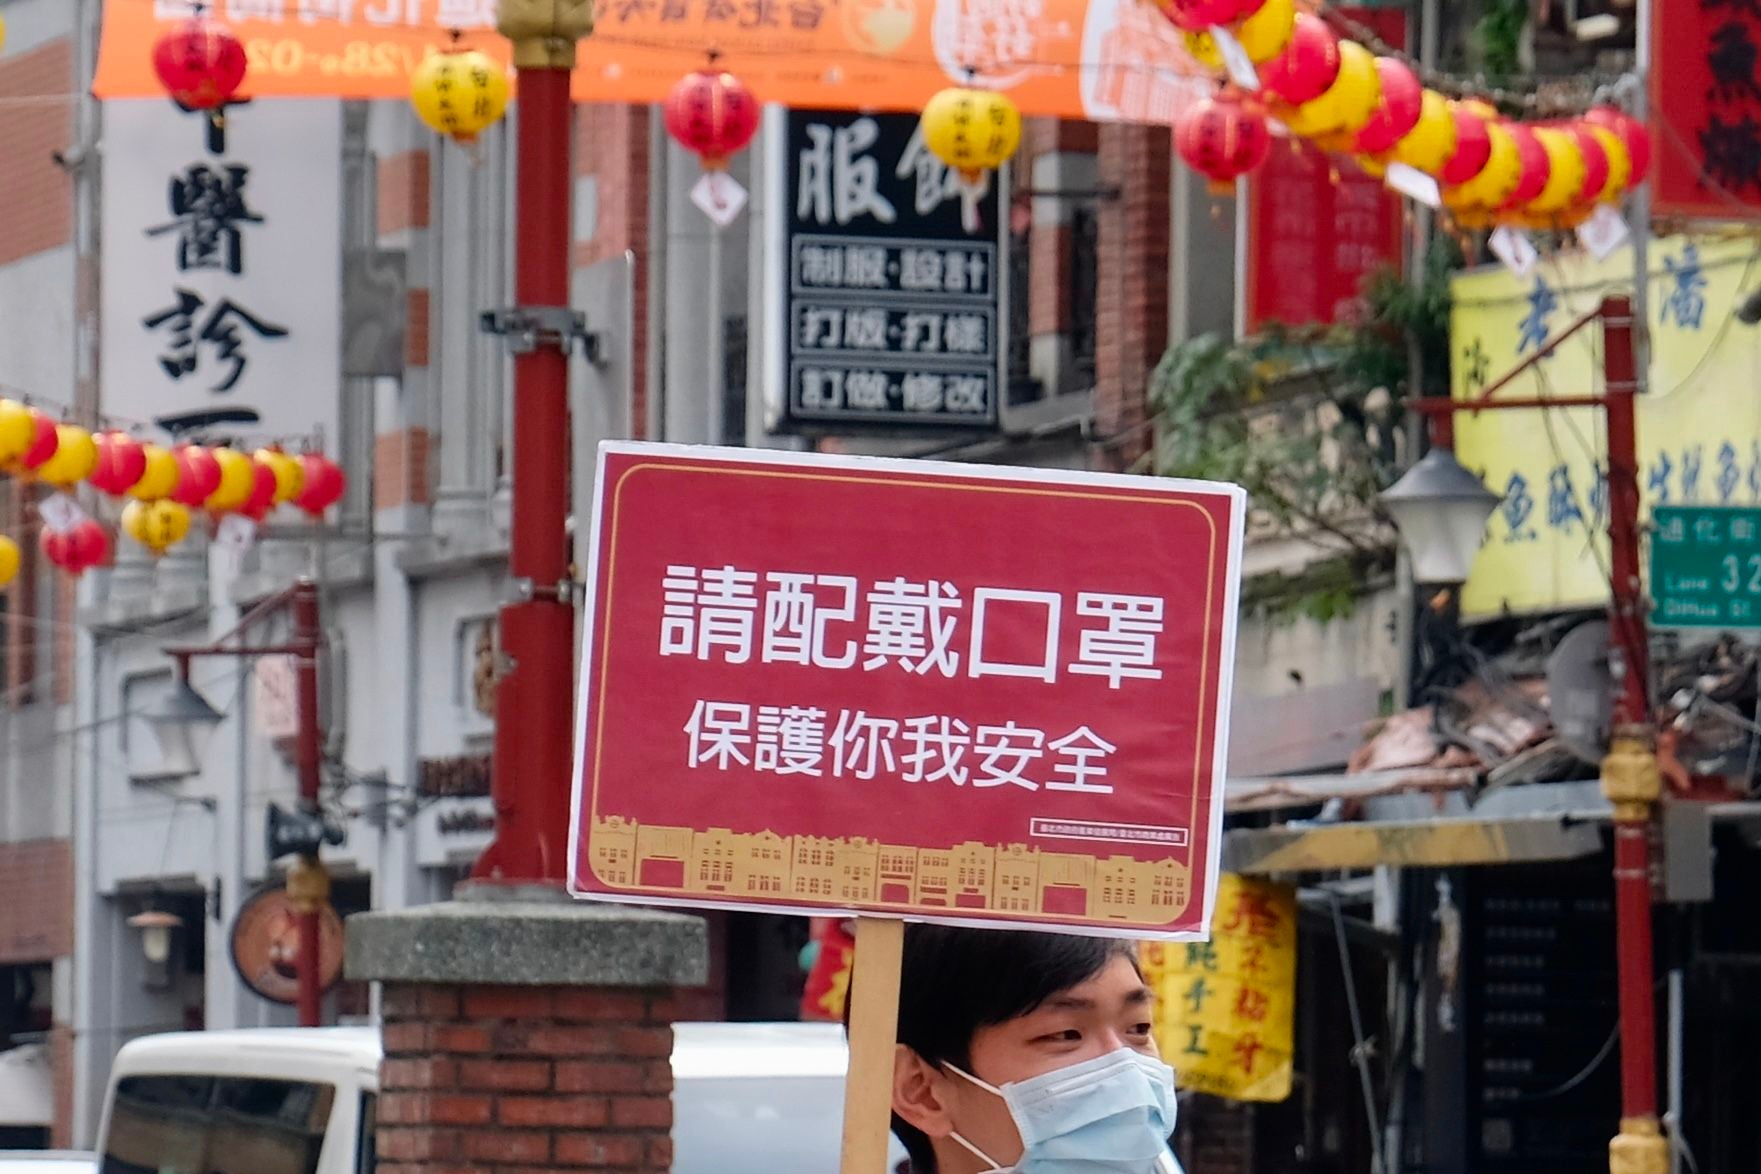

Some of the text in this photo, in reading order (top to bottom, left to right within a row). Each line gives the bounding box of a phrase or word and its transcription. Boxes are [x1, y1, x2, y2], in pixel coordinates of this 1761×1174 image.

[144, 98, 288, 447] 醫診
[660, 565, 1164, 689] 請配戴口罩
[683, 700, 1117, 794] 保護你我安全
